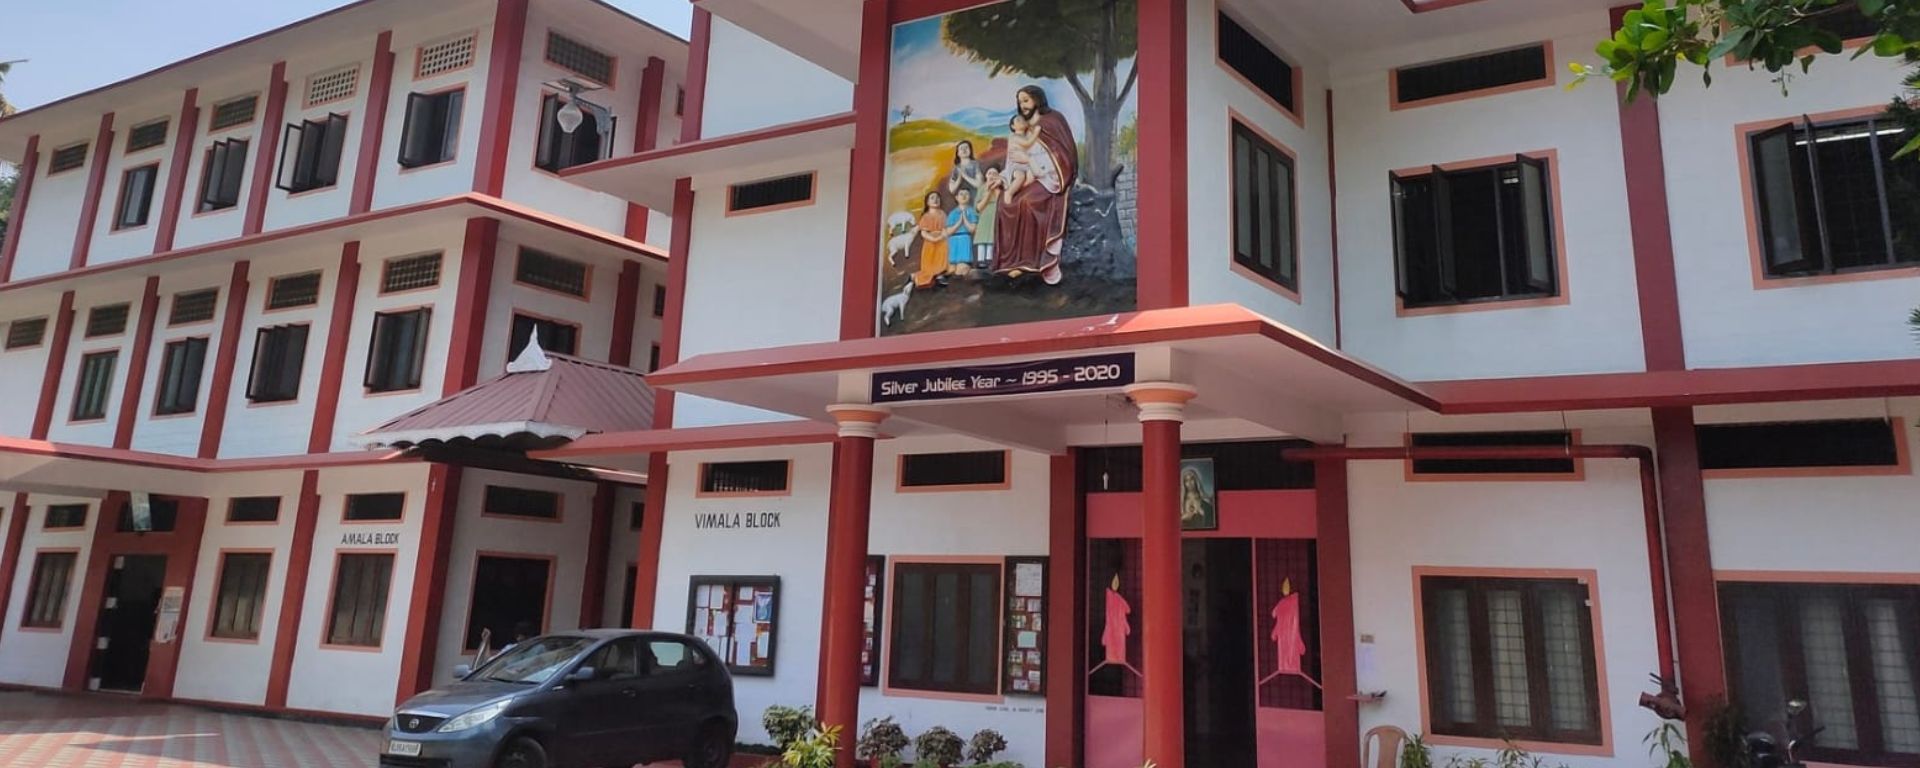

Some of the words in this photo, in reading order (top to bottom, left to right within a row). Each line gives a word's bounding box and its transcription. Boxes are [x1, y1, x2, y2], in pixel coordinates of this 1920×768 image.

[881, 380, 919, 396] Silver
[921, 377, 966, 393] Jubilee
[970, 375, 1001, 390] Year
[1022, 368, 1059, 386] 1995
[1073, 364, 1121, 382] 2020
[695, 513, 741, 528] VIMALA
[745, 512, 781, 528] BLOCK
[340, 532, 373, 545] AMALA
[375, 532, 400, 545] BLOCK
